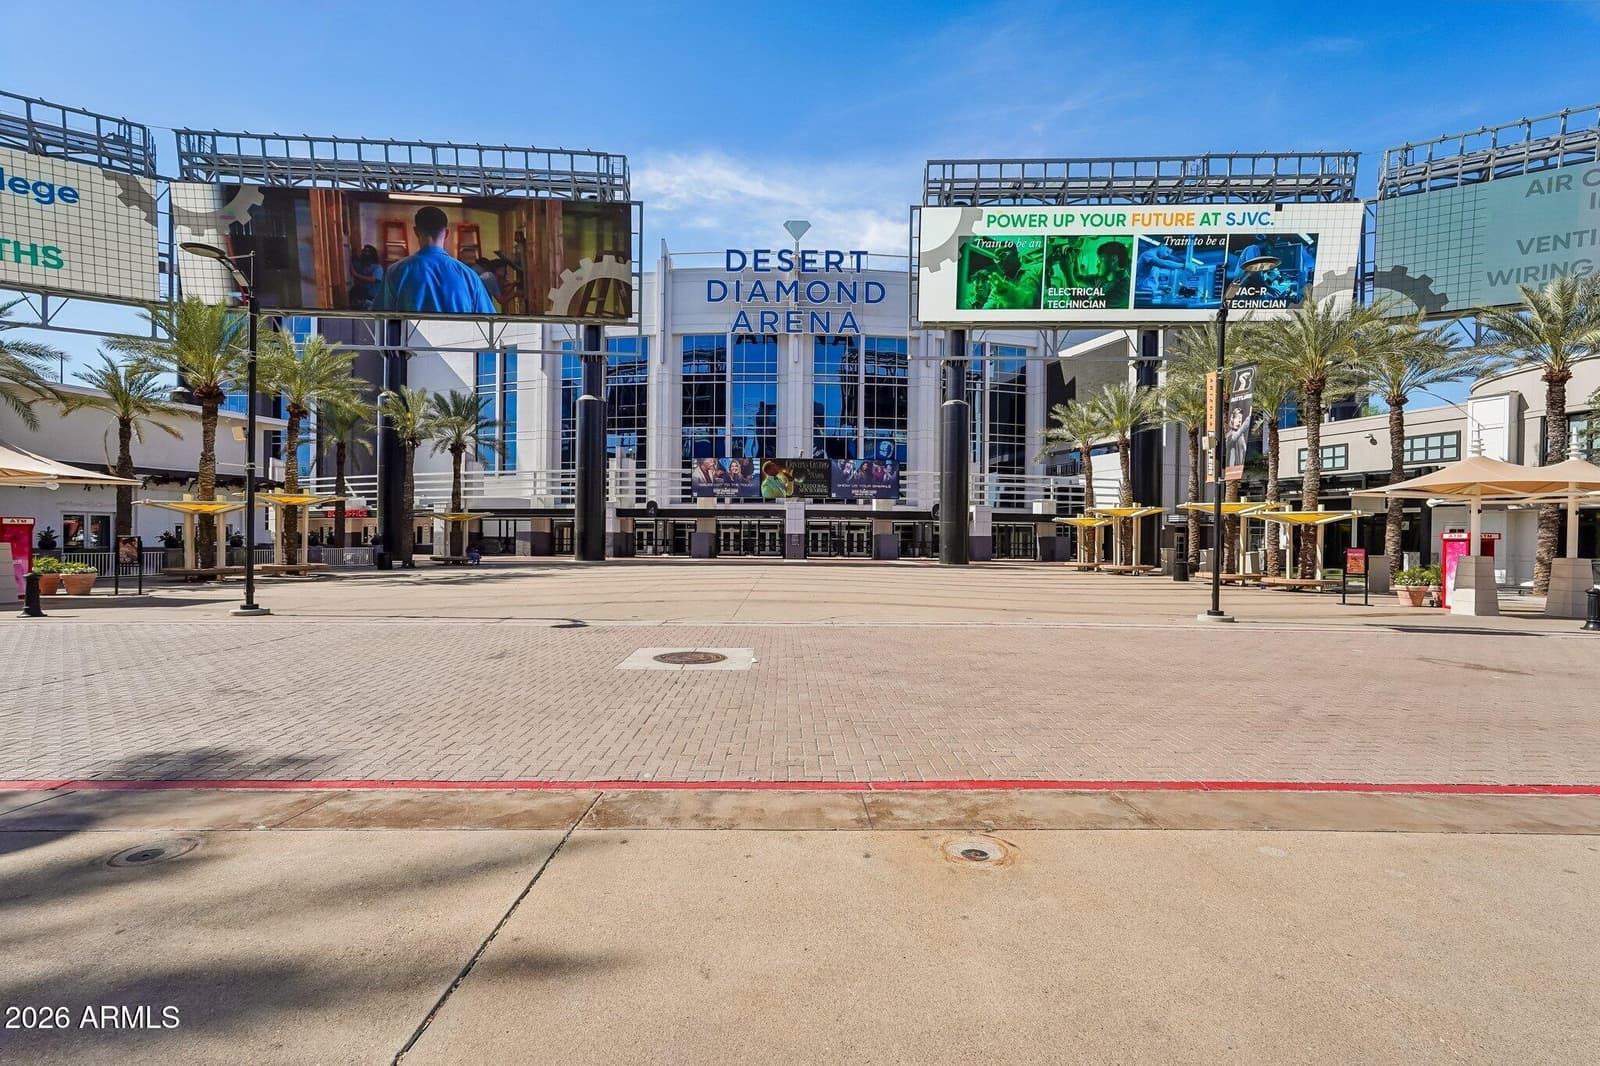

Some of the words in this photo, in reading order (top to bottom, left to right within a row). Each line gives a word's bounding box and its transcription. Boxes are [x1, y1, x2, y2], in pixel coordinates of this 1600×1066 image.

[1525, 174, 1573, 198] AIR
[986, 213, 1048, 228] POWER
[1053, 213, 1075, 227] UP
[1080, 213, 1127, 227] YOUR
[1131, 212, 1195, 226] FUTURE
[1199, 212, 1221, 226] AT
[1225, 211, 1275, 226] SJVC.
[974, 238, 1001, 249] Train
[1003, 238, 1014, 249] to
[1016, 238, 1027, 248] be
[1028, 239, 1042, 248] an
[1163, 235, 1190, 246] Train
[1193, 235, 1204, 246] to
[1205, 235, 1217, 246] be
[1218, 238, 1226, 246] a
[726, 249, 868, 273] DESERT
[1487, 258, 1594, 287] WIRING
[707, 279, 886, 304] DIAMOND
[1048, 287, 1105, 297] ELECTRICAL
[1235, 287, 1268, 296] VAC-R
[1047, 299, 1106, 309] TECHNICIAN
[1228, 299, 1287, 309] TECHNICIAN
[731, 310, 861, 334] ARENA
